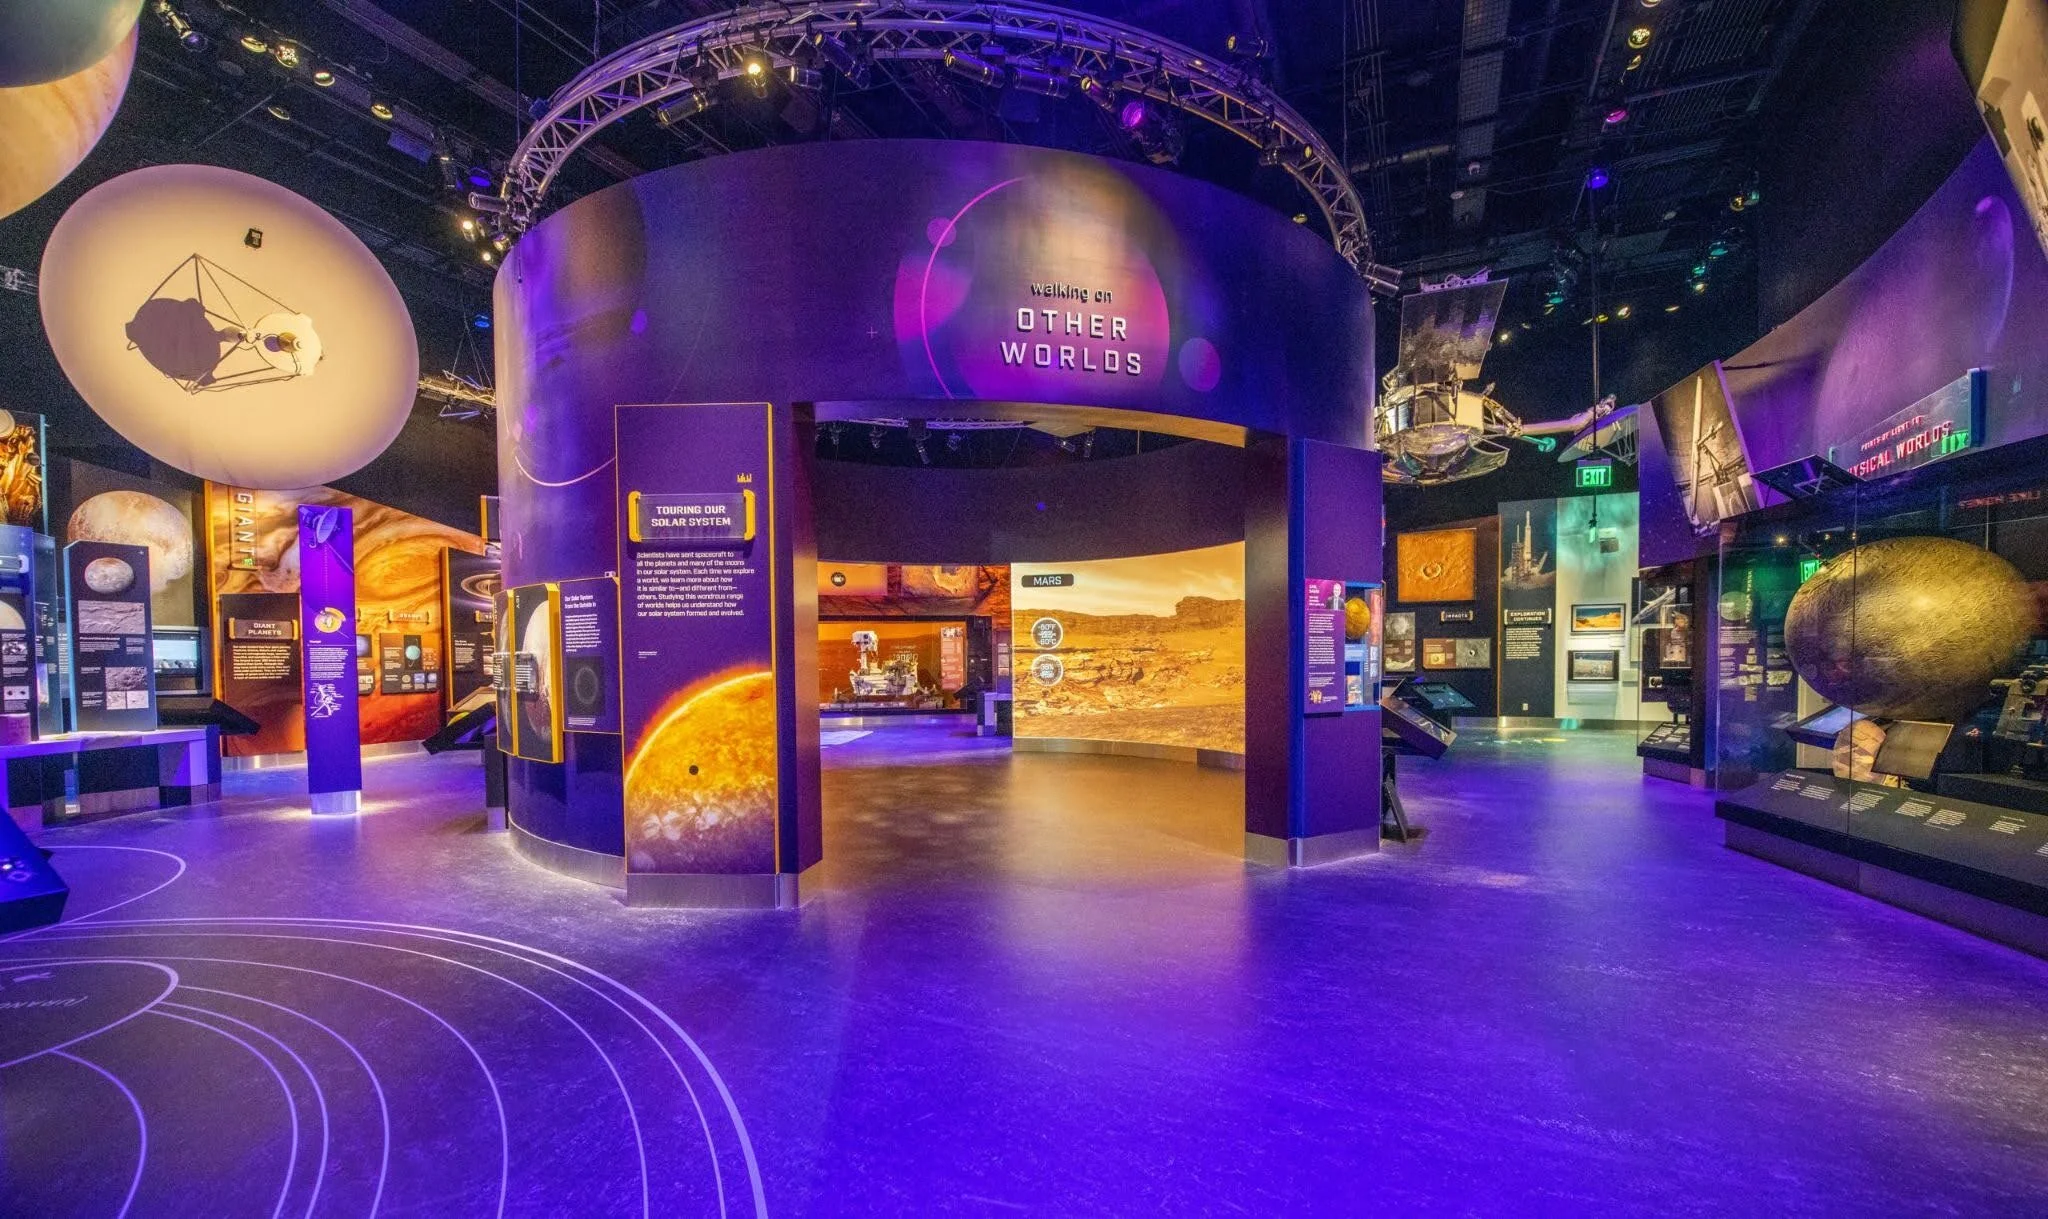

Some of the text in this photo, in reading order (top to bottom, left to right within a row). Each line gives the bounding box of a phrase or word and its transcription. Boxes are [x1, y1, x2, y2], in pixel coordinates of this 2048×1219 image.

[1031, 282, 1112, 303] walking on
[1017, 307, 1127, 341] OTHER
[1000, 341, 1141, 375] WORLDS
[1896, 420, 1953, 459] WORLDS
[1582, 468, 1606, 486] EXIT
[656, 505, 726, 515] TOURING OUR
[651, 517, 731, 527] SOLAR SYSTEM
[1033, 575, 1062, 586] MARS
